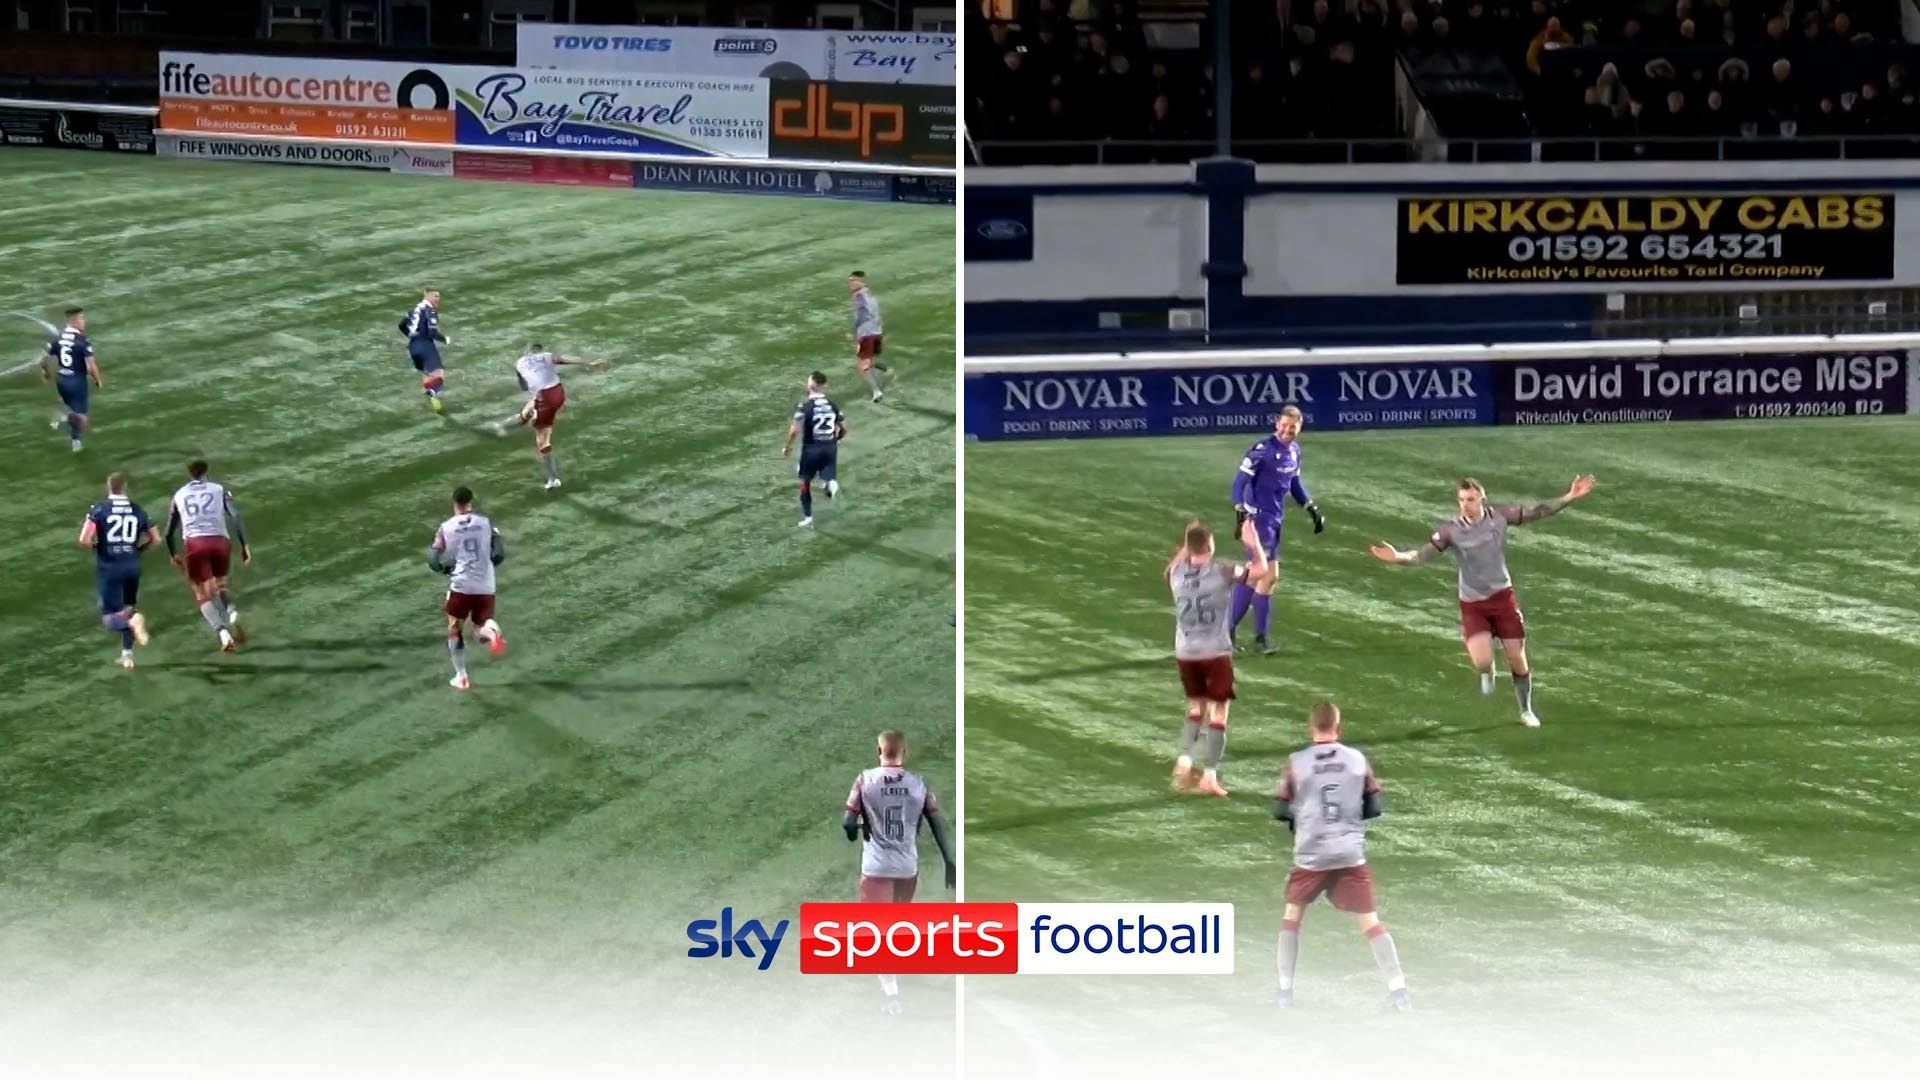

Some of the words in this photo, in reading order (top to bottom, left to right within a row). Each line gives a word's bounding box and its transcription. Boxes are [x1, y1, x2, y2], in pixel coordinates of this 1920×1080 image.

[610, 36, 673, 52] TIRES
[717, 40, 756, 52] point
[844, 49, 917, 74] Bay
[162, 62, 391, 104] fifeautocentre
[533, 75, 563, 85] LOCAL
[566, 77, 585, 86] BUS
[588, 77, 633, 88] SERVICES
[644, 80, 695, 90] EXECUTIVE
[699, 81, 731, 91] COACH
[732, 83, 756, 93] HIRE
[475, 73, 572, 137] Bay
[579, 91, 693, 125] Travel
[335, 124, 367, 137] 01592
[688, 117, 739, 128] COACHES
[742, 119, 764, 128] LTD
[689, 126, 723, 138] 01383
[774, 83, 904, 157] dbp
[179, 140, 206, 154] FIFE
[210, 142, 282, 158] WINDOWS
[285, 145, 317, 160] AND
[320, 147, 373, 162] DOORS
[642, 164, 693, 182] DEAN
[697, 168, 743, 185] PARK
[746, 170, 805, 189] HOTEL
[1408, 198, 1724, 233] KIRKCALDY
[1737, 196, 1885, 231] CABS
[1508, 235, 1629, 262] 01592
[1640, 233, 1782, 260] 654321
[1467, 264, 1580, 280] Kirkcaldy's
[1583, 264, 1680, 279] Favourite
[1684, 262, 1725, 277] Taxi
[1729, 263, 1825, 279] Company
[60, 345, 73, 367] 6
[1172, 372, 1314, 406] NOVAR
[1338, 367, 1477, 401] NOVAR
[1514, 364, 1622, 401] David
[1635, 361, 1802, 398] Torrance
[1815, 355, 1899, 392] MSP
[1003, 376, 1148, 411] NOVAR
[1172, 415, 1209, 428] FOOD
[1216, 414, 1258, 427] DRINK
[1338, 410, 1373, 423] FOOD
[1382, 409, 1422, 422] DRINK
[1430, 407, 1477, 421] SPORTS
[1515, 409, 1580, 426] Kirkcaldy
[1583, 407, 1672, 424] Constituency
[1749, 403, 1791, 418] 01592
[1795, 401, 1846, 416] 200349
[812, 412, 836, 435] 23
[1003, 420, 1041, 434] FOOD
[1050, 418, 1091, 432] DRINK
[1099, 416, 1148, 431] SPORTS
[184, 492, 214, 517] 62
[106, 514, 138, 543] 20
[463, 537, 479, 562] 9
[1176, 593, 1216, 626] 26
